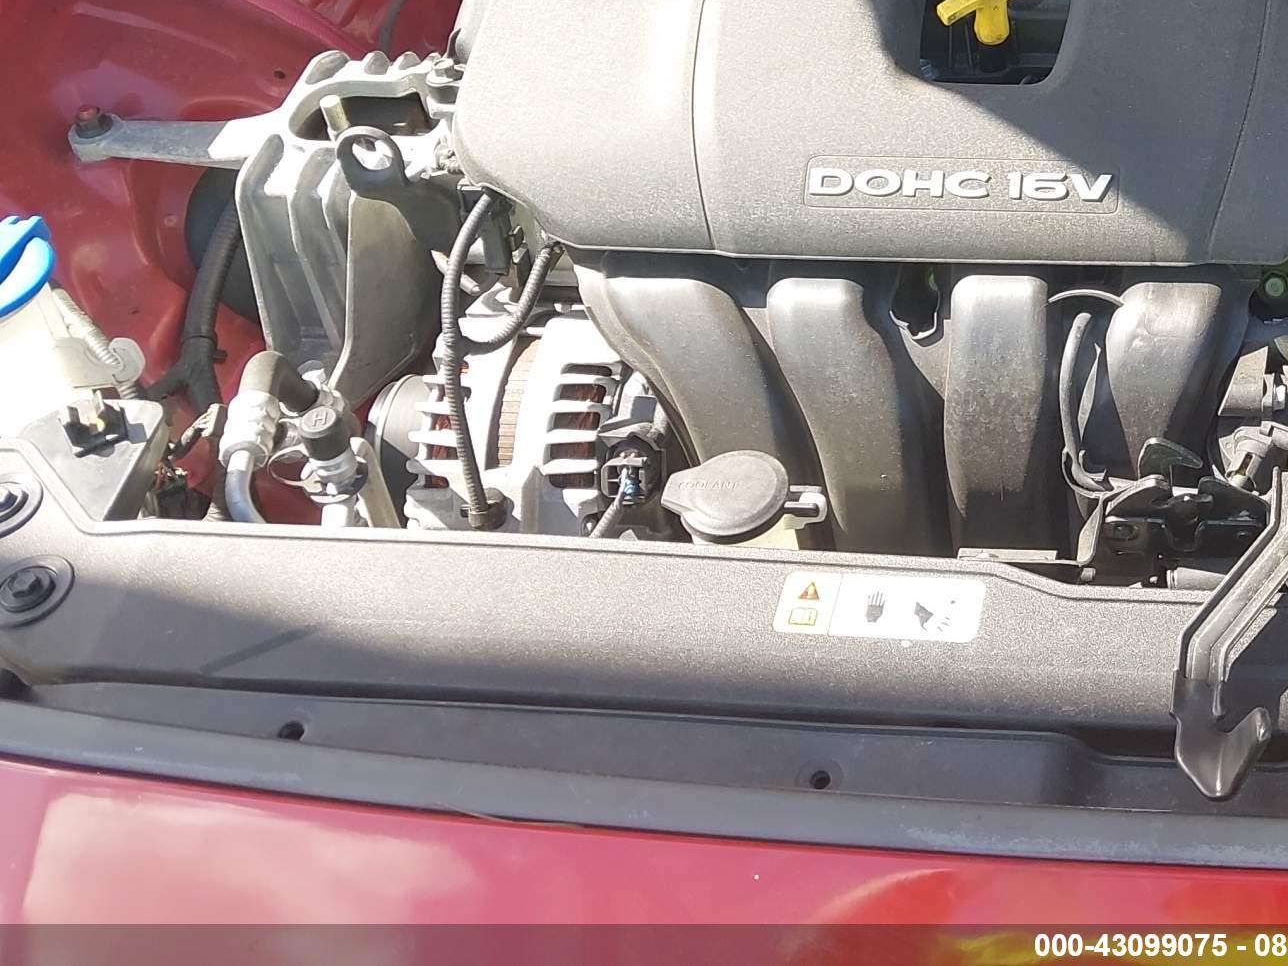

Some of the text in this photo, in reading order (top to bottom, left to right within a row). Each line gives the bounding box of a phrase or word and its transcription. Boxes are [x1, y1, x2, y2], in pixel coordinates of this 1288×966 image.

[807, 166, 1114, 203] DOHC 16V
[311, 410, 329, 428] H
[677, 480, 739, 491] COOLANT
